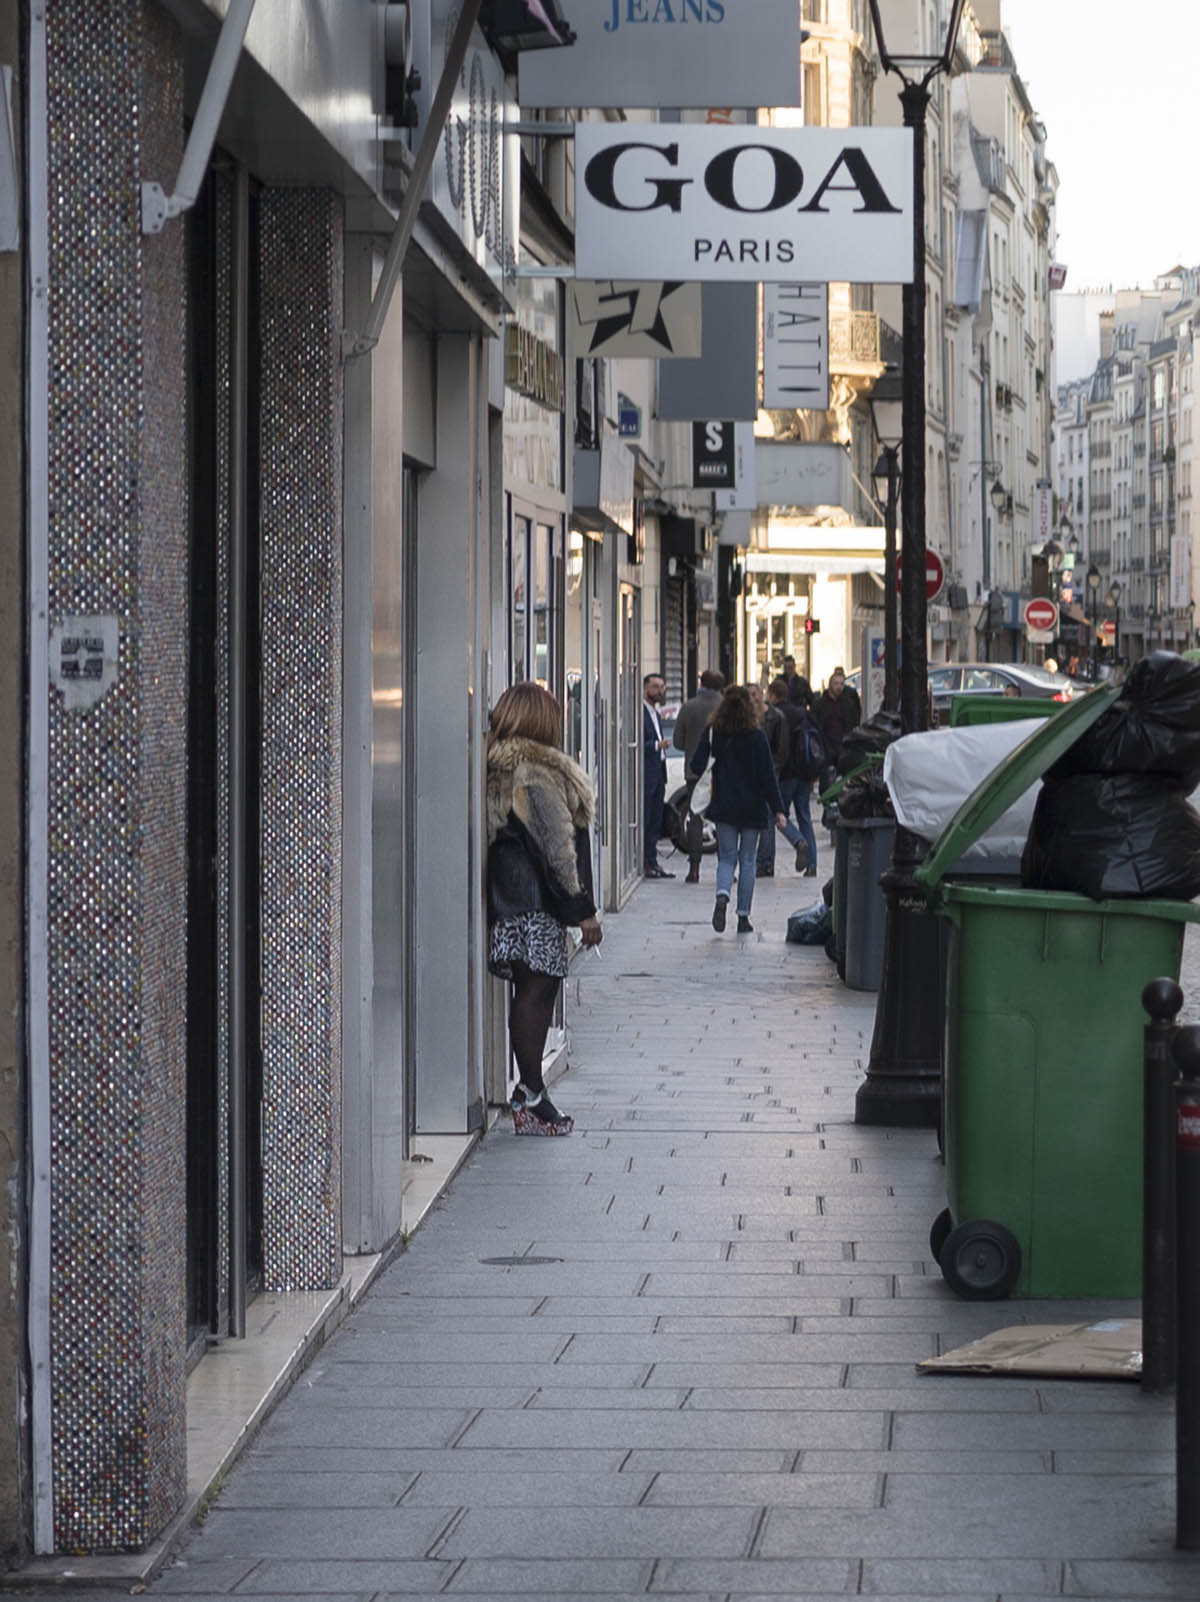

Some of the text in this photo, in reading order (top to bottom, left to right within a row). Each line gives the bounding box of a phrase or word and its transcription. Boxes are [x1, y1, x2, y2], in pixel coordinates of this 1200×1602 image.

[603, 0, 726, 33] JEANS
[583, 141, 904, 214] GOA
[694, 239, 795, 263] PARIS
[705, 420, 724, 453] S
